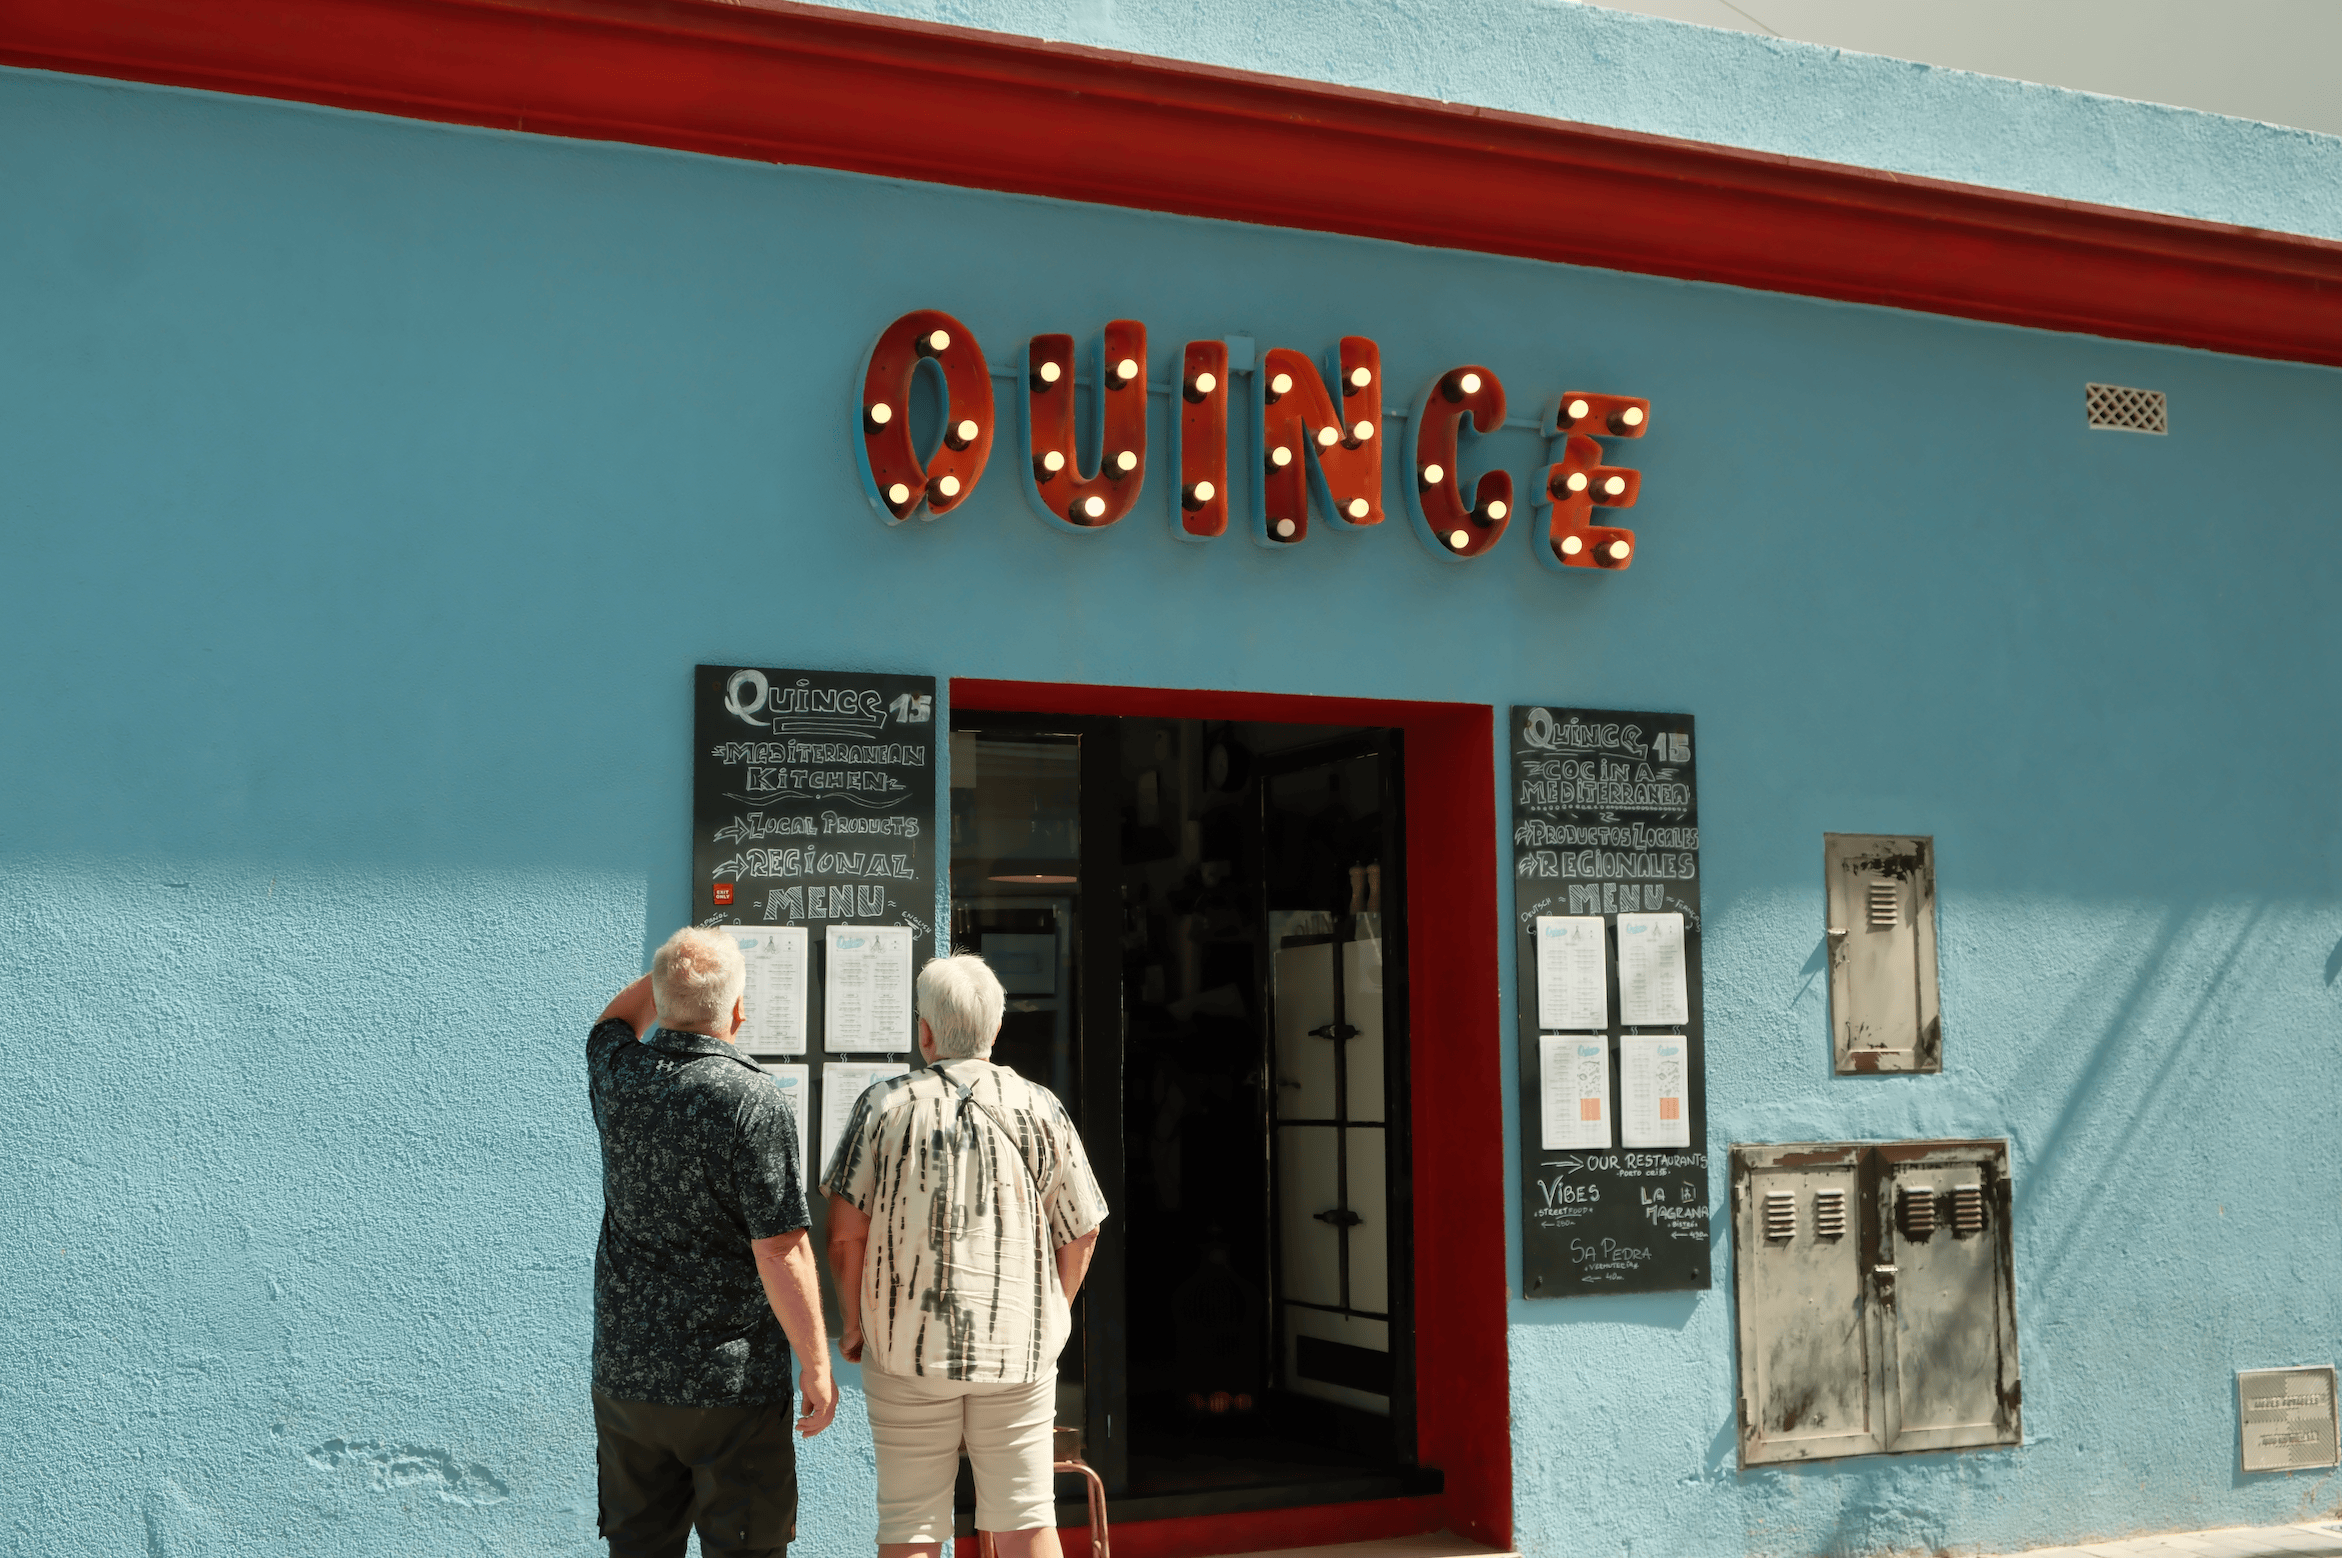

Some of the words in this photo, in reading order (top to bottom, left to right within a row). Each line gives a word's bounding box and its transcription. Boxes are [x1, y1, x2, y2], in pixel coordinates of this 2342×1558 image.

[889, 693, 932, 723] 15
[1652, 732, 1691, 762] 15
[1537, 849, 1695, 879] REGIONALES
[763, 885, 885, 920] MENU
[1521, 897, 1552, 923] DEUTSCH
[1568, 883, 1665, 914] MENU
[901, 911, 932, 934] ENGLISH
[1586, 1155, 1620, 1171] OUR
[1624, 1153, 1708, 1169] RESTAURANTS
[1640, 1186, 1666, 1205] LA
[1646, 1204, 1709, 1226] MAGRANA
